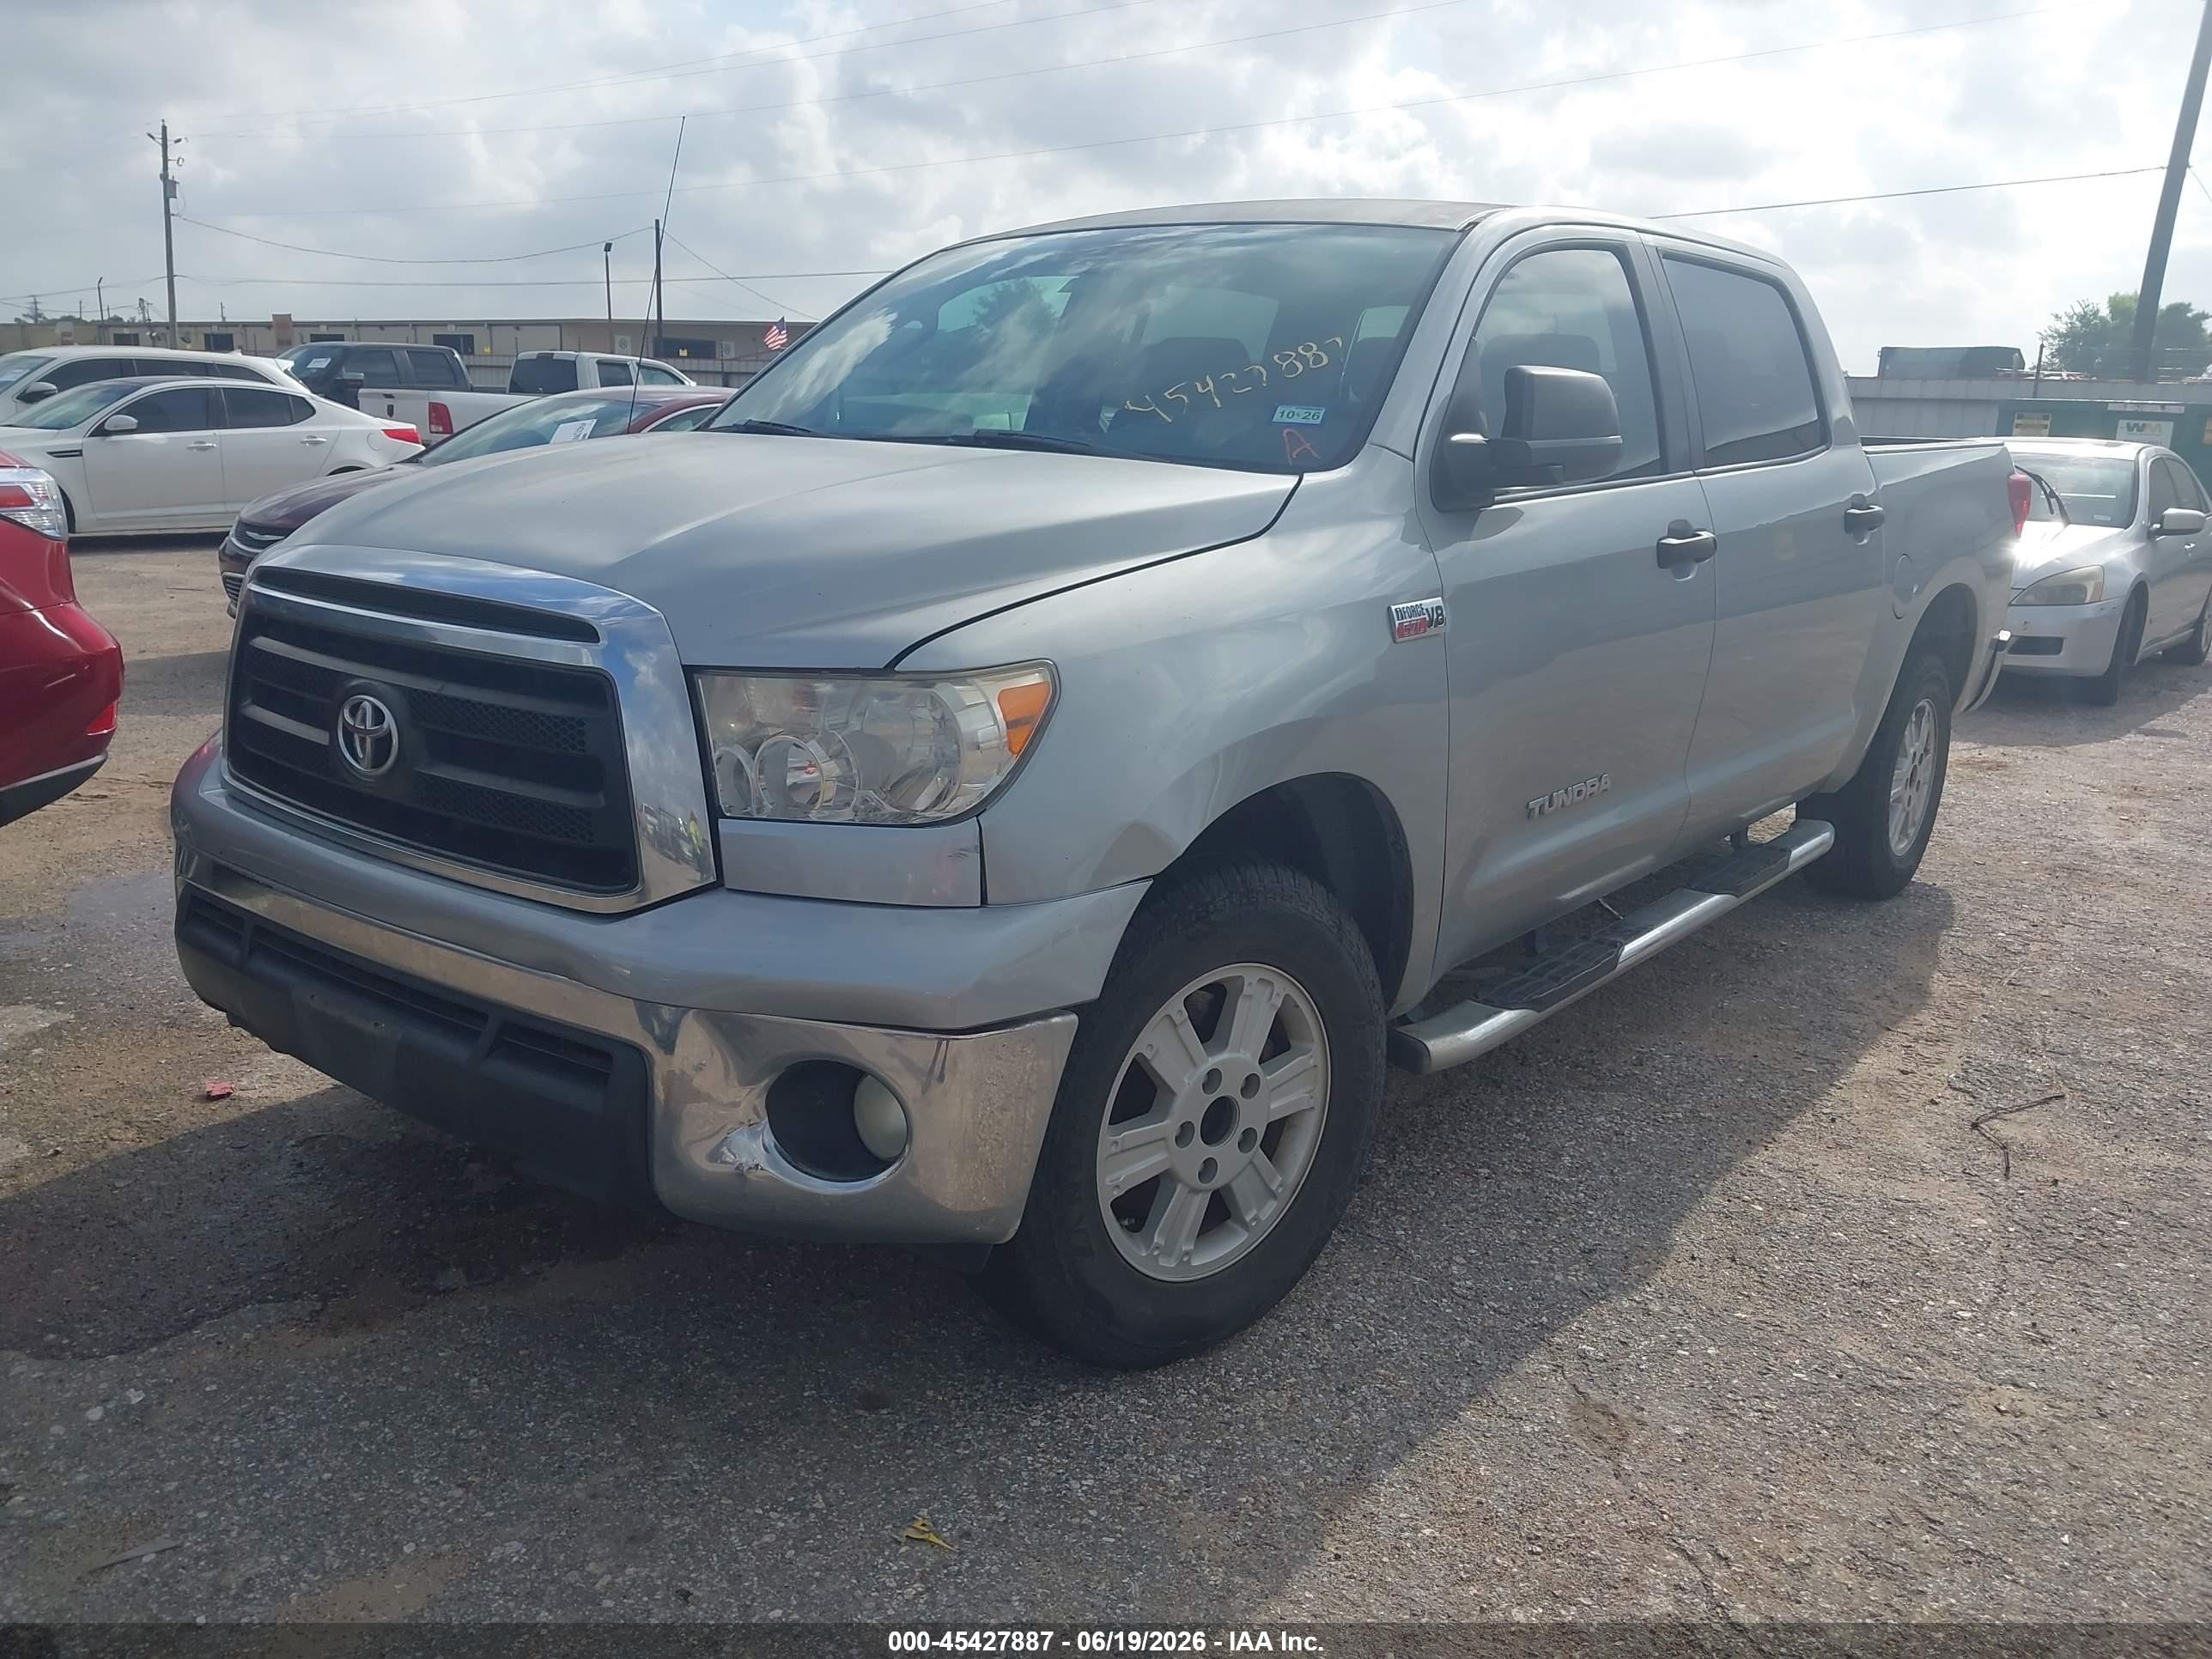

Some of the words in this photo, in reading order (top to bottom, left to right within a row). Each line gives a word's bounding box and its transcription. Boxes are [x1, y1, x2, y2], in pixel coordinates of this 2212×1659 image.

[1302, 411, 1321, 421] 26
[2125, 422, 2162, 434] WM
[1282, 428, 1321, 465] A
[1425, 605, 1445, 629] V8
[1526, 773, 1613, 820] TUNDRA
